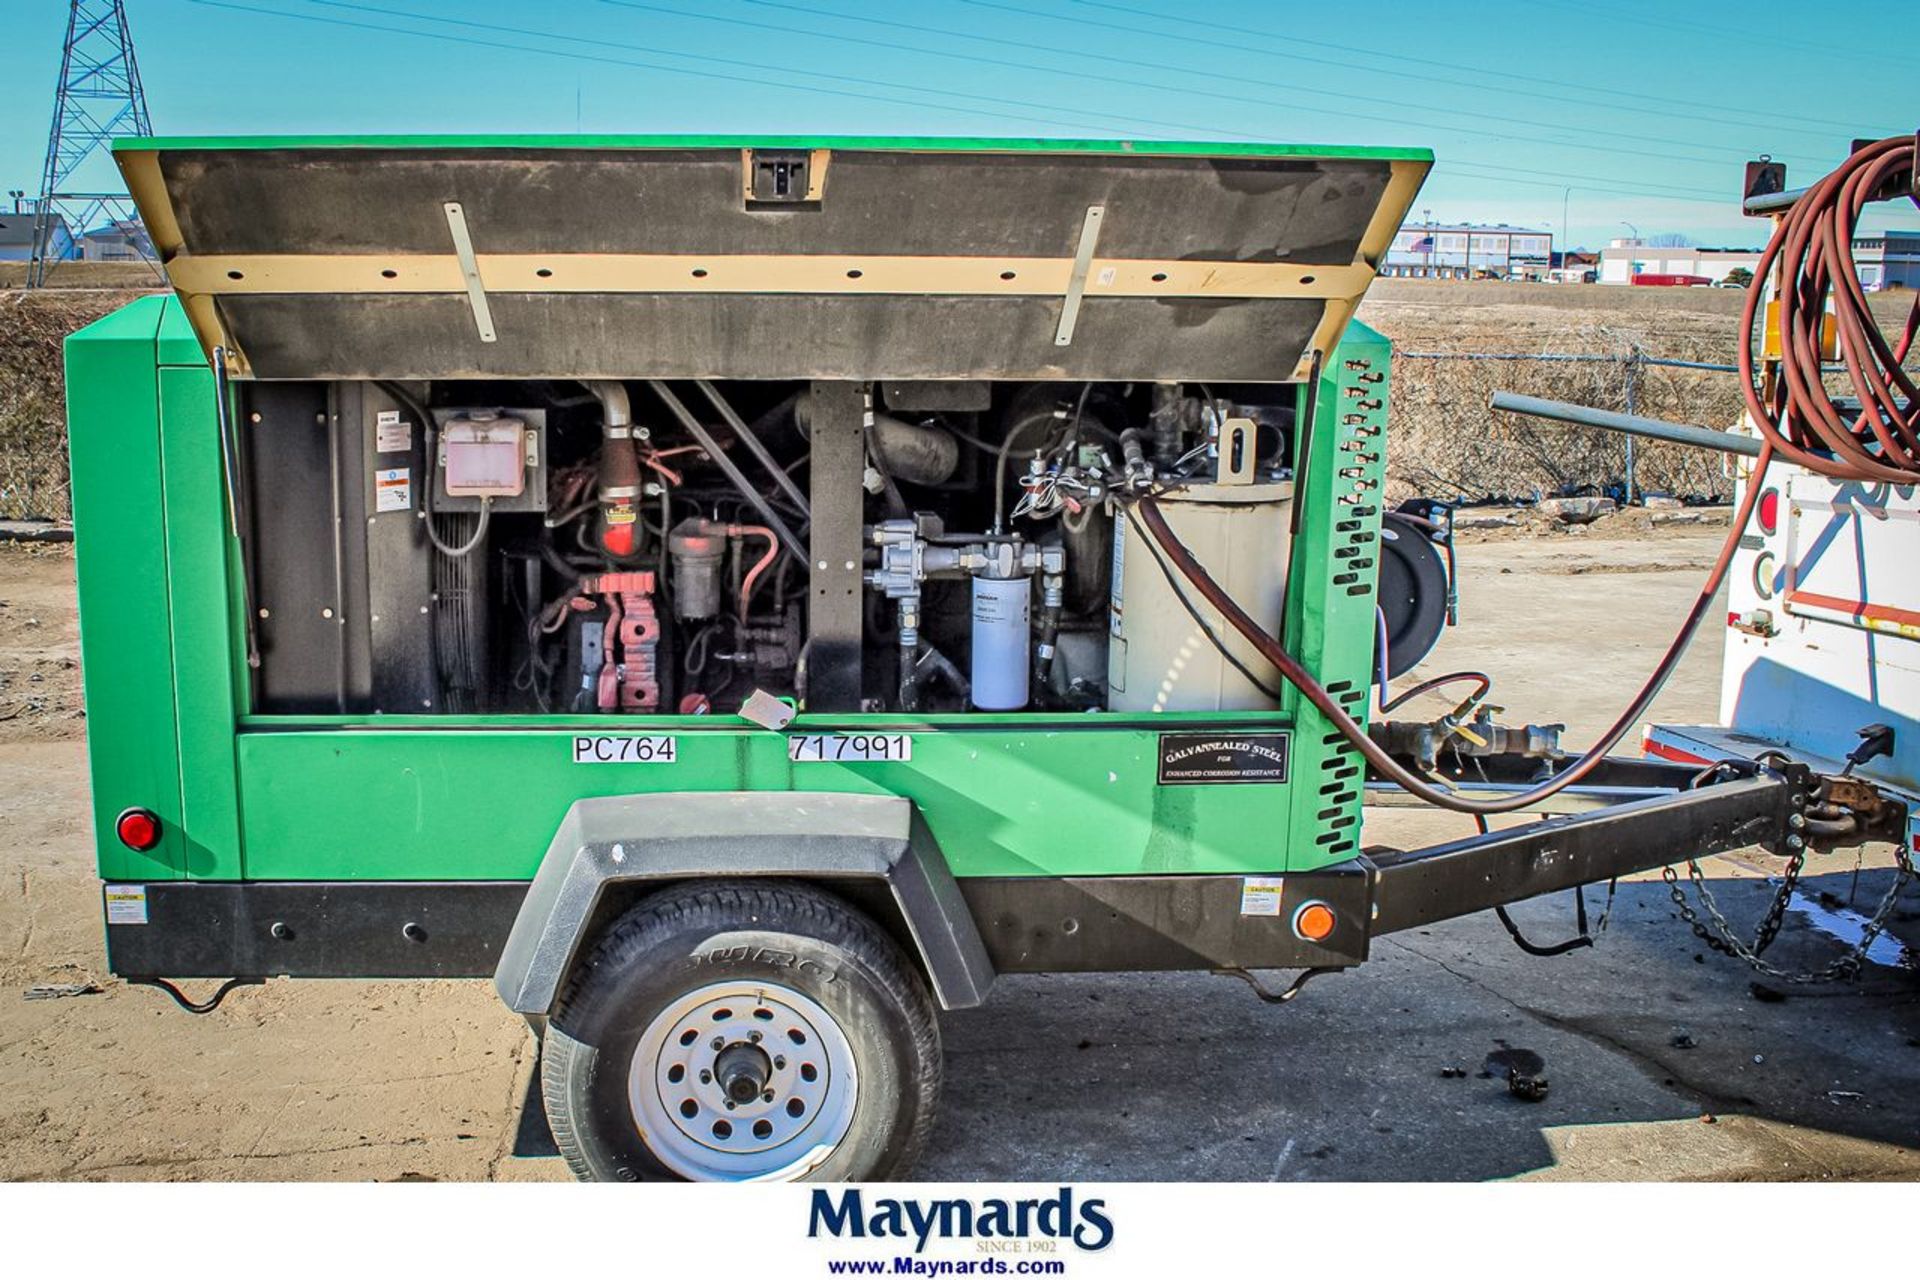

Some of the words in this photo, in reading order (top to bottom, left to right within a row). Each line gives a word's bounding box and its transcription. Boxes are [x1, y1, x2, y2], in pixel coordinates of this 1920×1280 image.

[575, 737, 674, 761] PC764
[792, 736, 911, 760] 717991
[1165, 742, 1250, 763] GALVANNEALED
[1252, 745, 1281, 762] STEEL
[1241, 769, 1280, 777] RESISTANCE
